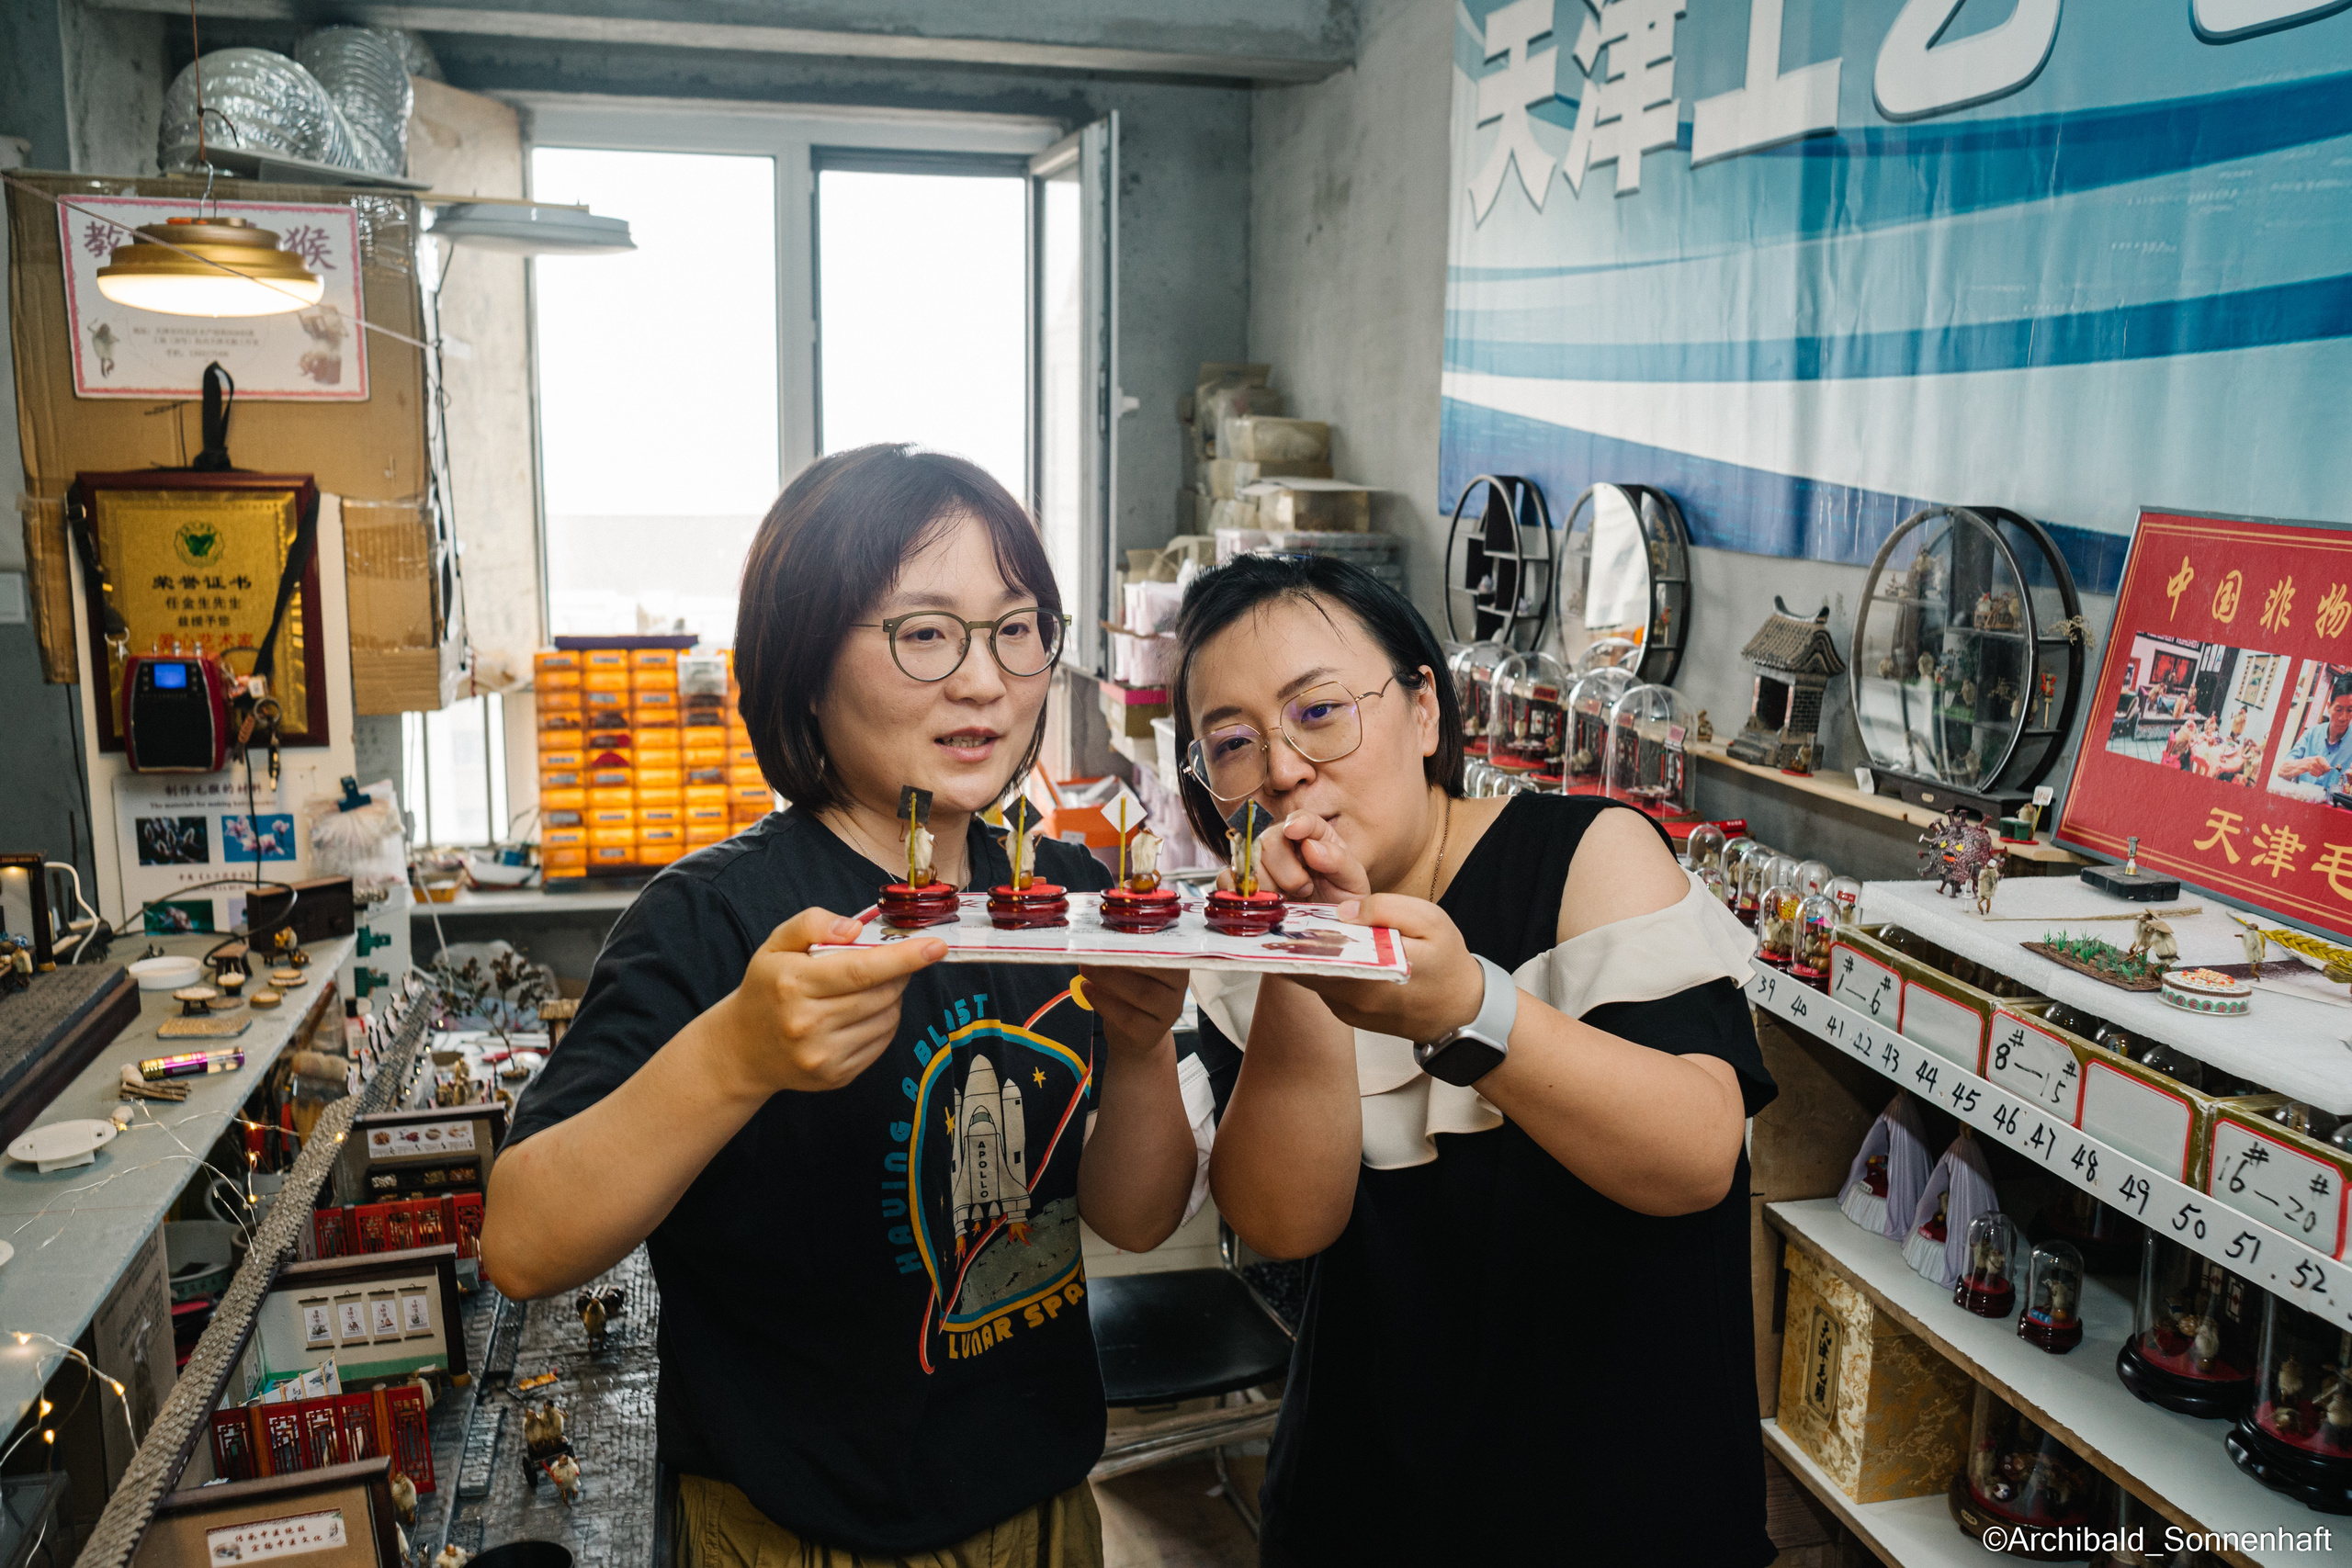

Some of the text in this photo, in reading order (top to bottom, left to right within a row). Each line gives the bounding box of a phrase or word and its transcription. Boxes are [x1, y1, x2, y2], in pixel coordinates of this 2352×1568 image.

[152, 575, 252, 591] 荣誉证书
[1757, 975, 2327, 1293] 39 40 41 42 43 44 45 46 47 48 49 50 51 52
[978, 1141, 989, 1199] APOLLO
[948, 1316, 1014, 1359] LUNAR
